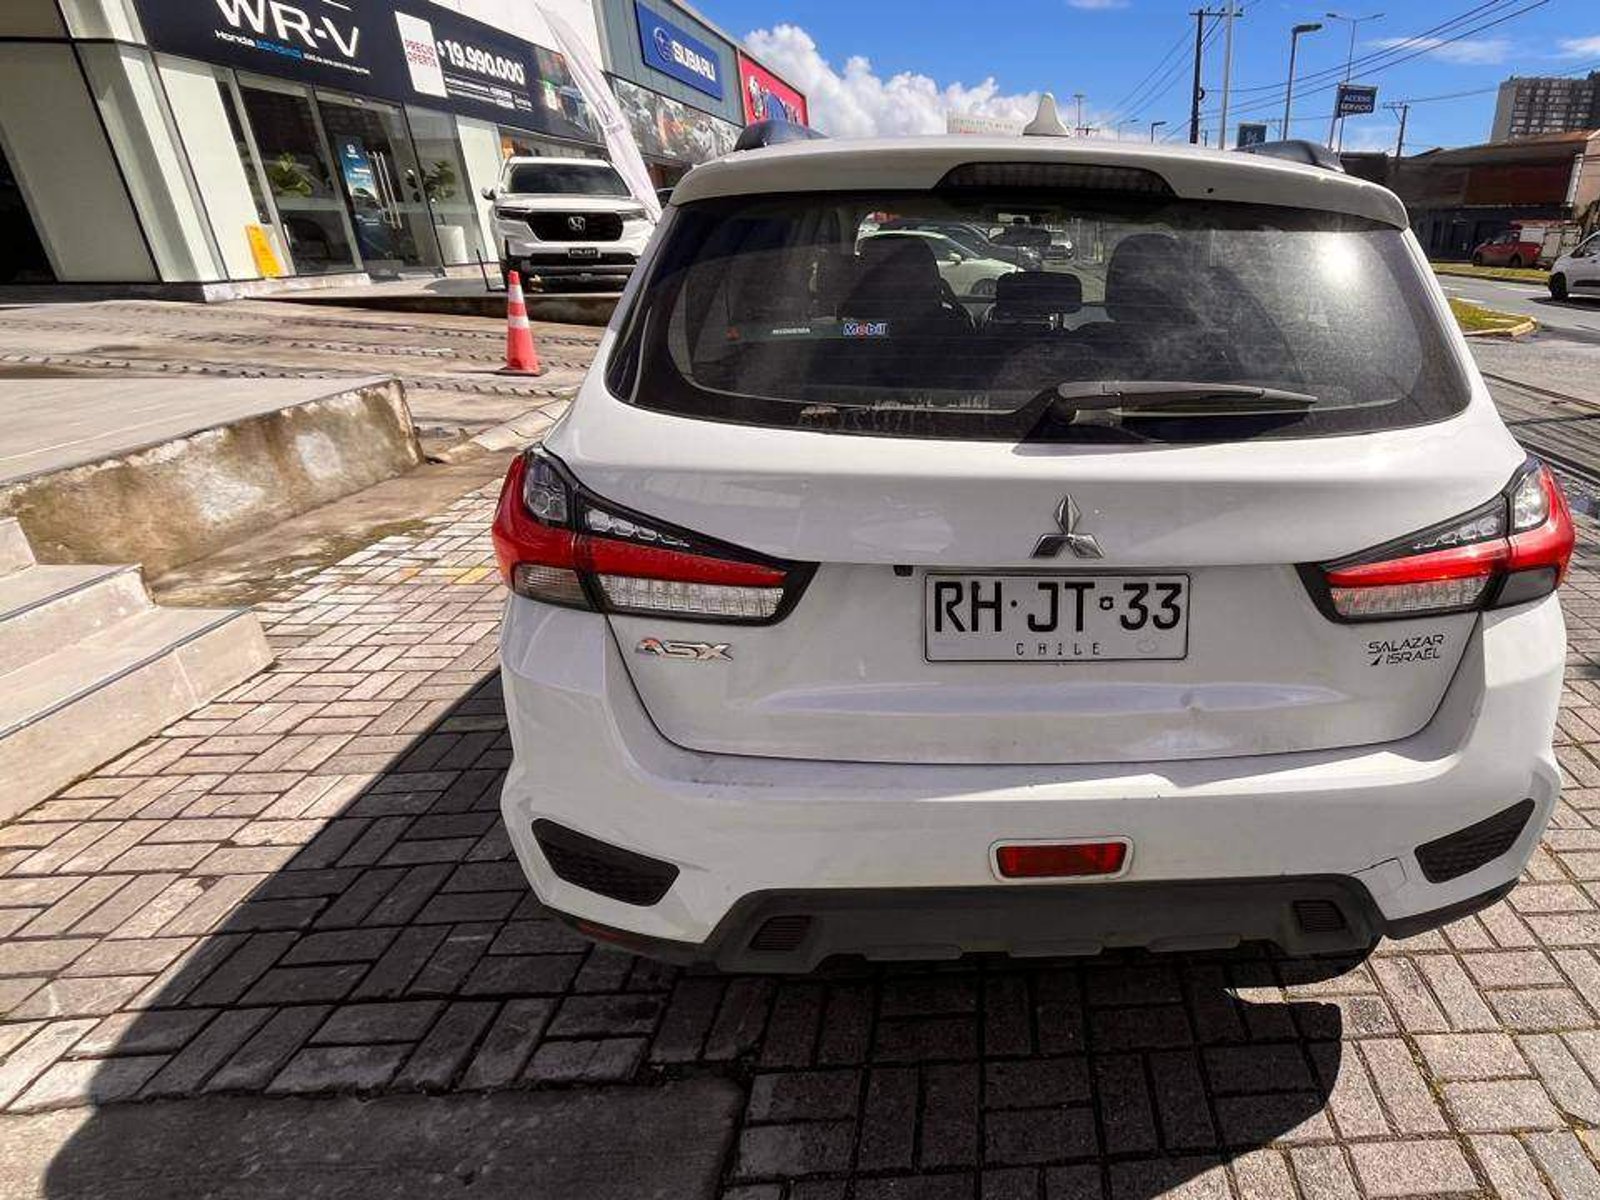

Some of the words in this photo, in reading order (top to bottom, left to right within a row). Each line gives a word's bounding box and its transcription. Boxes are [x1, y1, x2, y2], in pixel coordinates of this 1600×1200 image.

[214, 29, 256, 47] Honda
[216, 0, 360, 58] WR-V
[671, 40, 716, 82] SUBARU
[843, 322, 888, 338] Mobil
[636, 638, 734, 661] ASX
[1016, 643, 1101, 656] CHILE
[1368, 634, 1444, 654] SALAZAR
[1386, 647, 1440, 664] ISRAEL
